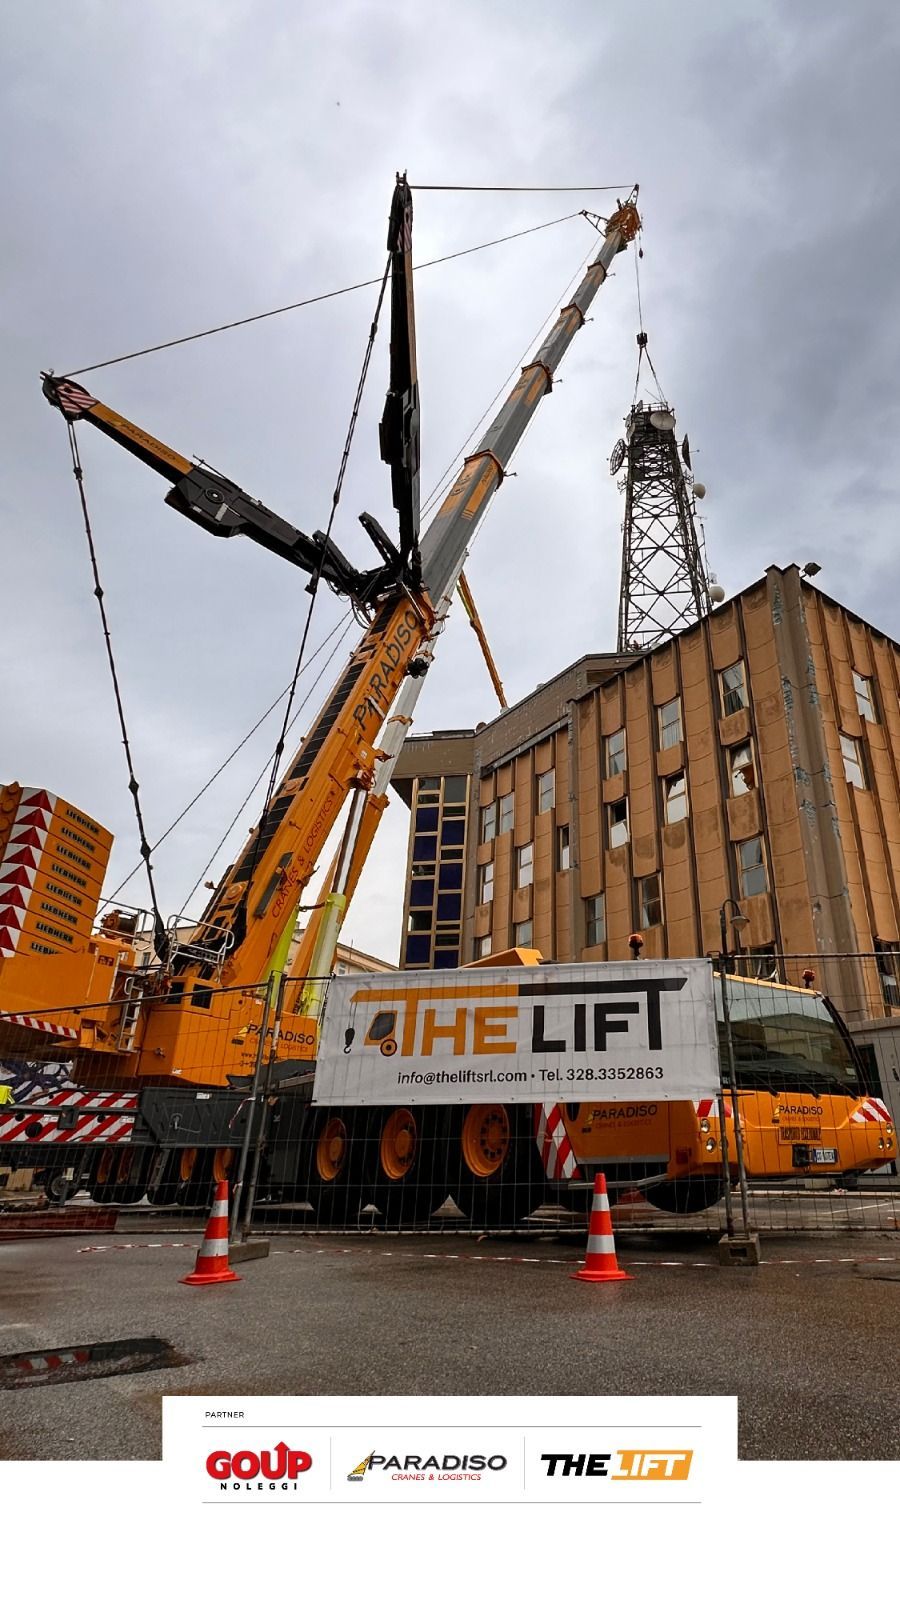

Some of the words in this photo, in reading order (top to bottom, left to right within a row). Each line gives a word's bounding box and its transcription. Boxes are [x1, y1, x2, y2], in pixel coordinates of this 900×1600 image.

[353, 609, 418, 731] PARADISO
[272, 866, 298, 918] CRANES
[304, 799, 333, 853] LOGISTICS
[52, 863, 87, 887] LIEBHERR
[46, 883, 82, 906] LIEBHERR
[41, 902, 78, 924] LIEBHERR
[36, 922, 74, 943] LIEBHERR
[351, 983, 518, 1057] THE
[518, 977, 688, 1054] LIFT
[247, 1024, 315, 1045] PARADISO
[397, 1069, 527, 1085] info@theliftsrl.com
[538, 1068, 563, 1081] Tel.
[566, 1067, 664, 1080] 328.3352863
[592, 1104, 658, 1121] PARADISO
[779, 1105, 823, 1116] PARADISO
